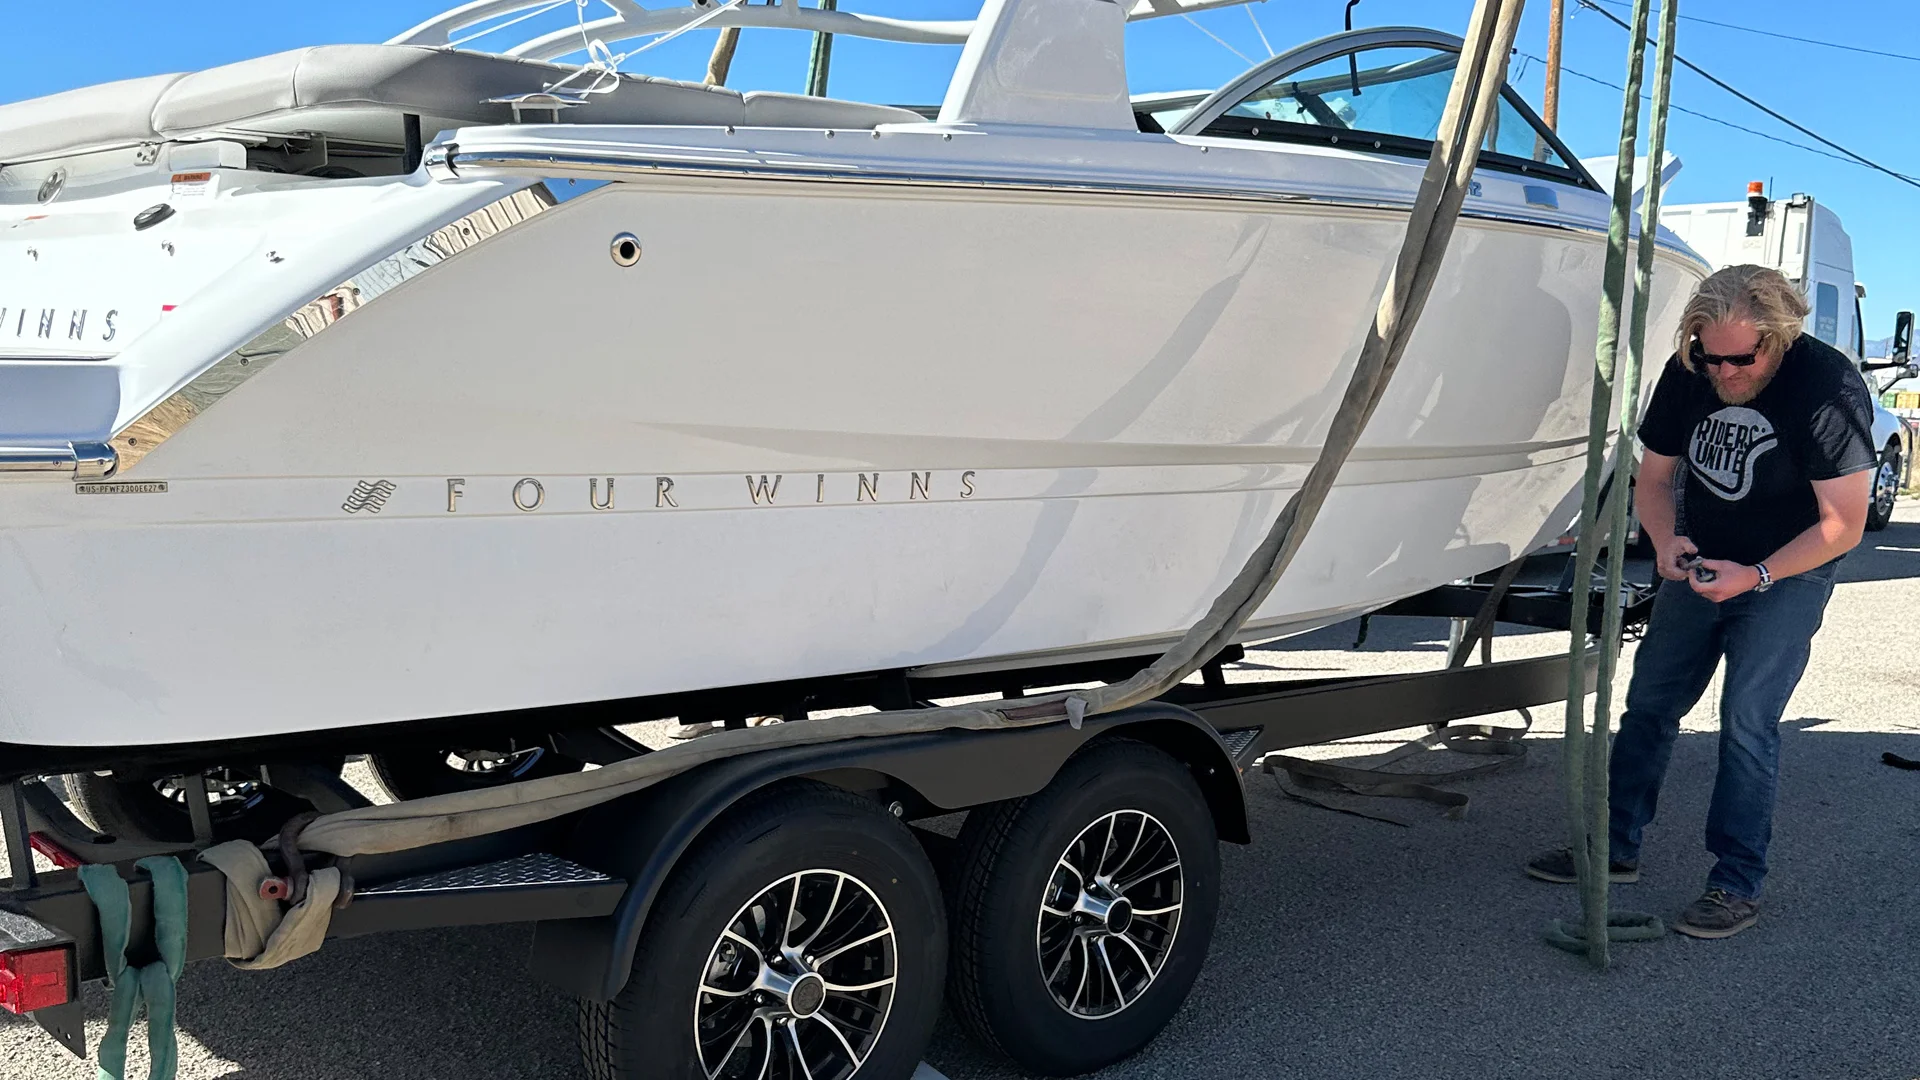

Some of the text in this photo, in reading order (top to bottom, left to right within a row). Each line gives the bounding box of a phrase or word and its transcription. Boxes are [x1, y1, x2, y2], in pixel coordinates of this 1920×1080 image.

[1696, 417, 1760, 450] RIDERS
[1695, 440, 1743, 474] UNITE
[446, 470, 977, 513] FOUR WINNS
